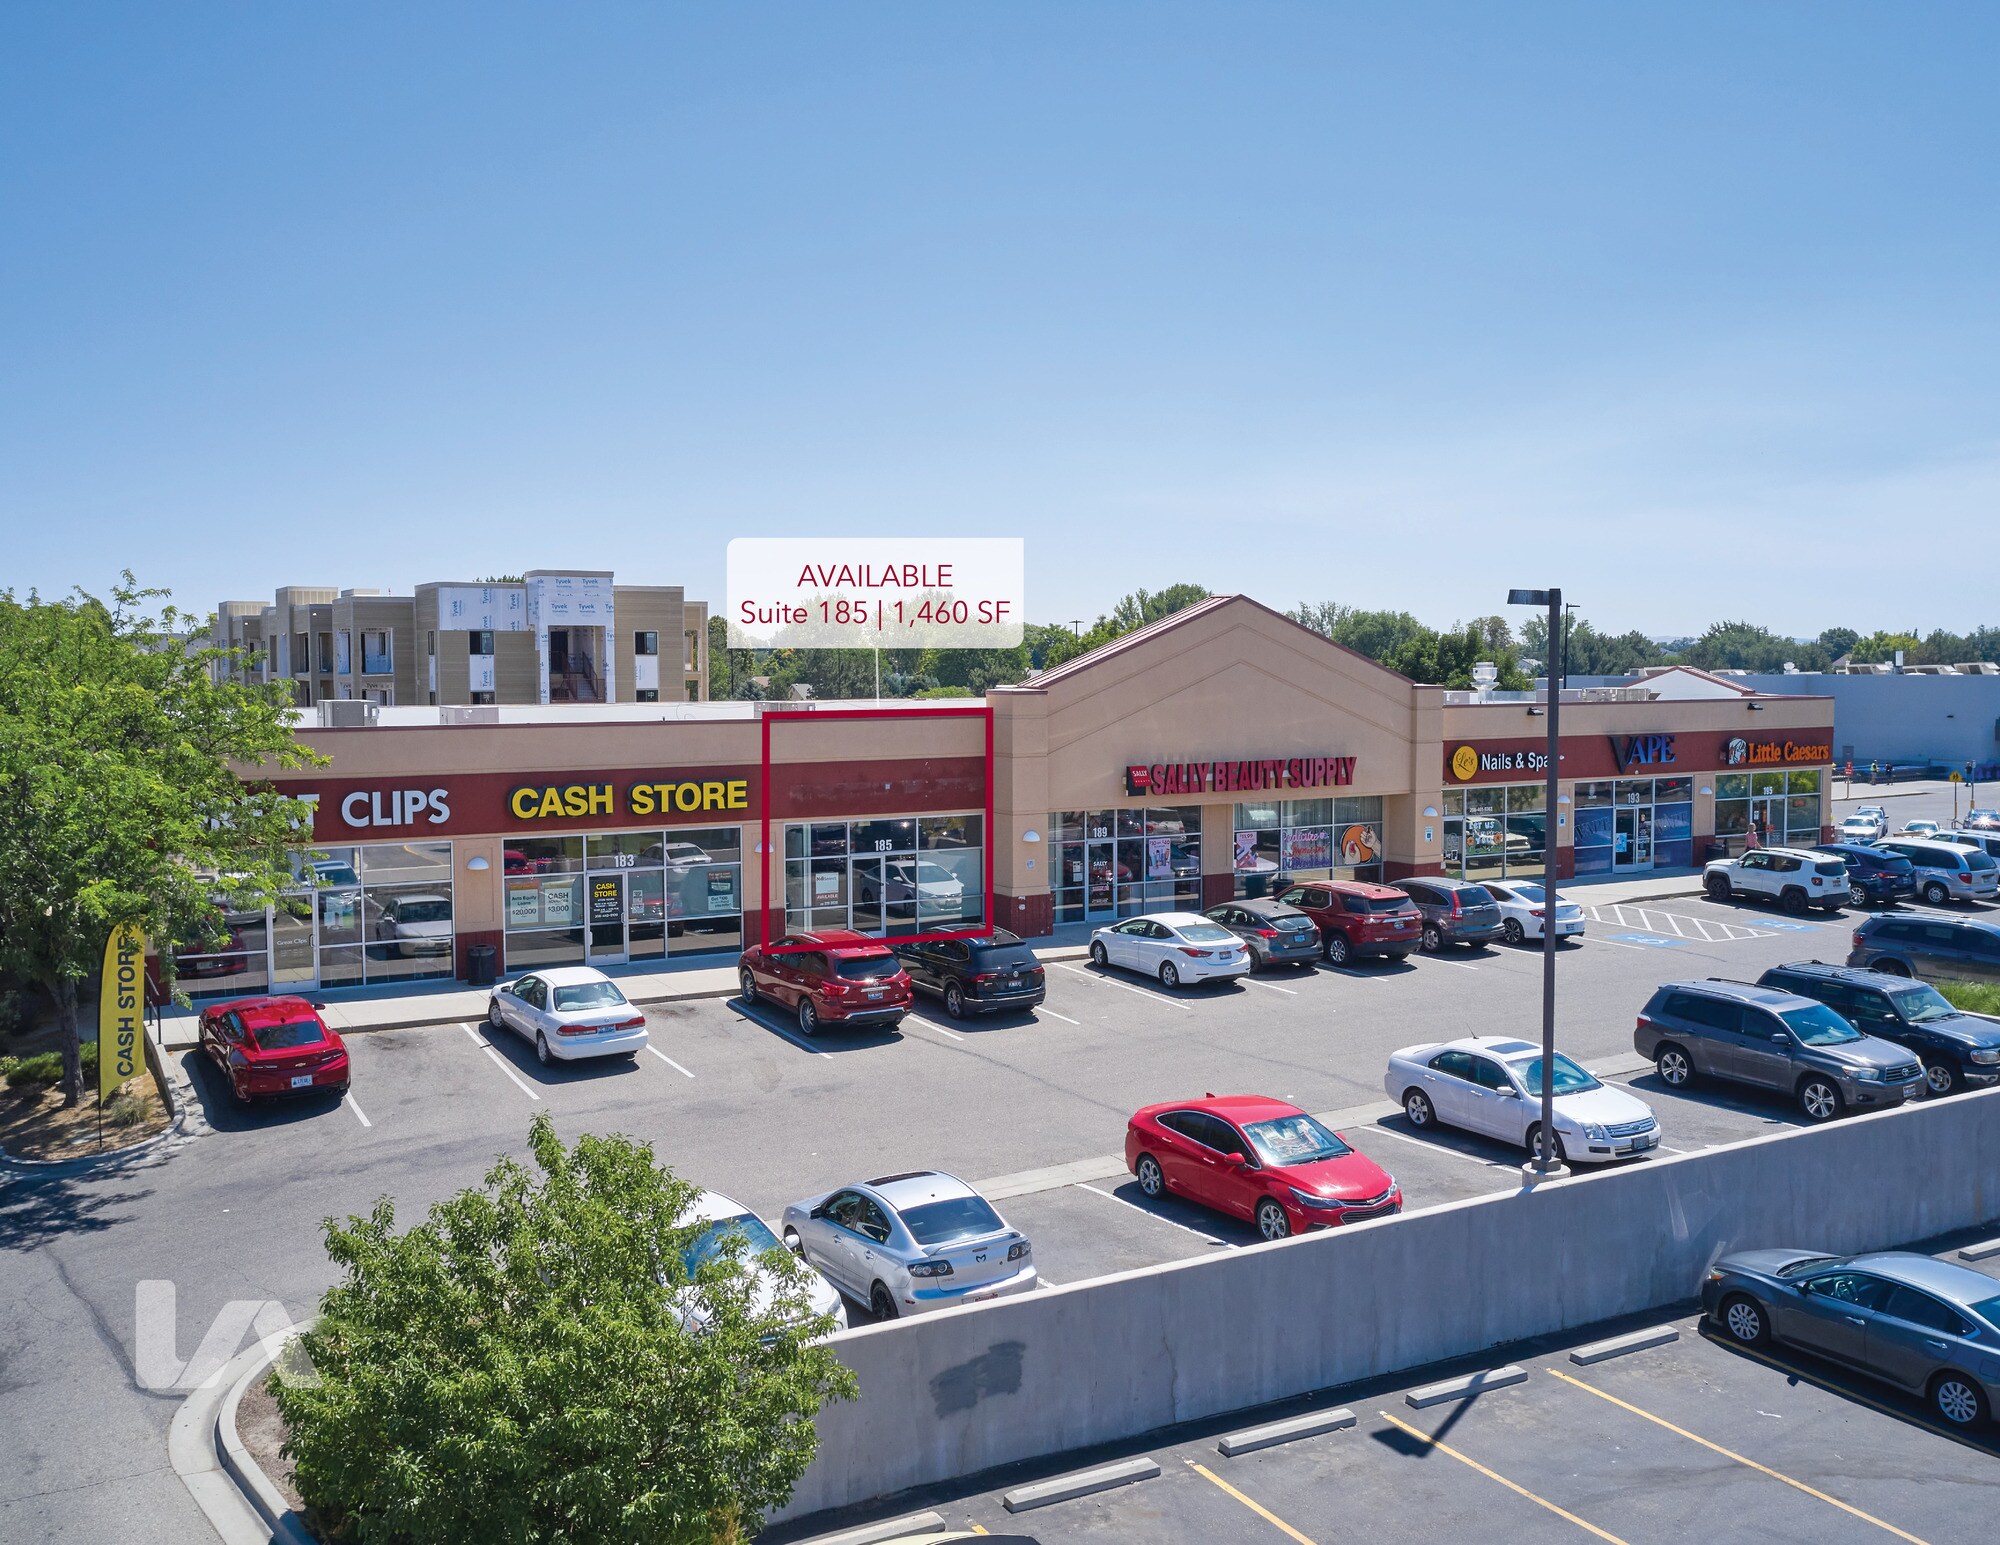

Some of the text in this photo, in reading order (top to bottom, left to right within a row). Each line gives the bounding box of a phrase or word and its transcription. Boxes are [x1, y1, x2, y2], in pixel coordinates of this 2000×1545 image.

[1607, 735, 1676, 774] VAPE
[1748, 741, 1829, 763] Little Caesars
[1481, 752, 1548, 772] Nails & Spa
[1151, 757, 1357, 795] SALLY BEAUTY SUPPLY
[511, 780, 748, 819] CASH STORE
[1627, 793, 1640, 803] 193
[1763, 787, 1773, 795] 195
[341, 788, 451, 827] CLIPS
[1092, 827, 1108, 838] 189
[874, 839, 893, 851] 185
[614, 854, 635, 868] 183
[548, 892, 569, 900] CASH
[594, 890, 617, 898] STORE
[117, 1017, 135, 1077] CASH
